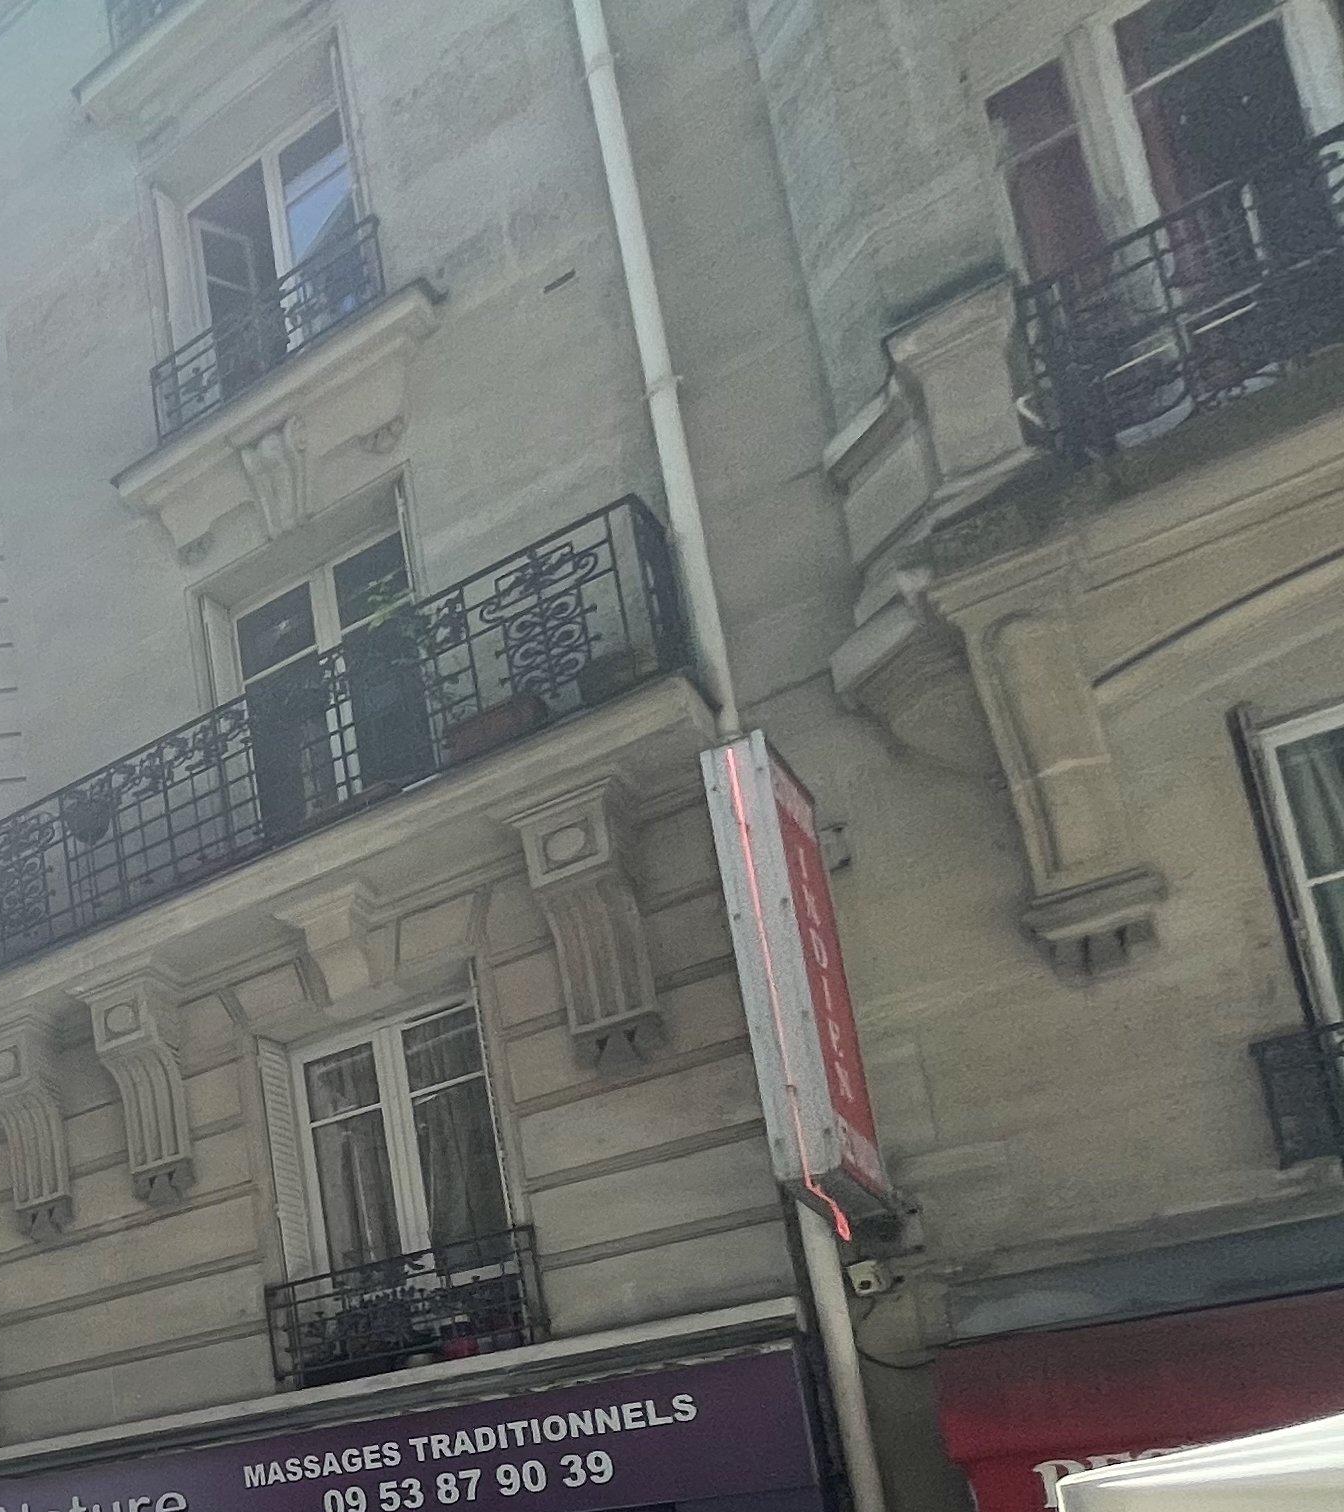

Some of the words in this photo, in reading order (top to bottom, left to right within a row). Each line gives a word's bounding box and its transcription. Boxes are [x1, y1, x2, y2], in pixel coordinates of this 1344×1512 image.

[243, 1441, 402, 1489] MASSAGES
[408, 1393, 698, 1463] TRADITIONNELS
[379, 1477, 424, 1512] 53
[436, 1468, 481, 1506] 87
[496, 1459, 547, 1497] 90
[561, 1450, 613, 1488] 39
